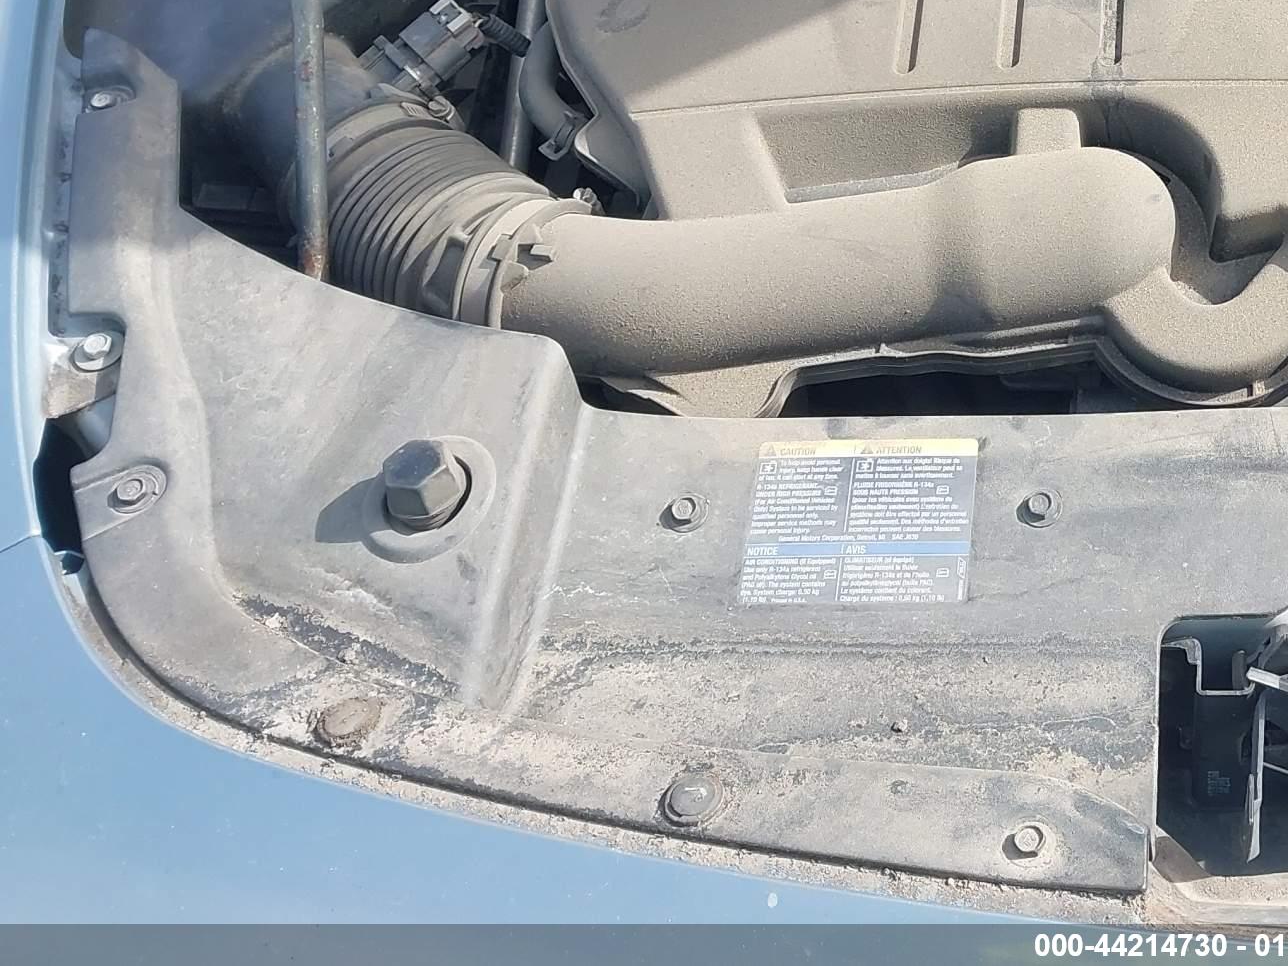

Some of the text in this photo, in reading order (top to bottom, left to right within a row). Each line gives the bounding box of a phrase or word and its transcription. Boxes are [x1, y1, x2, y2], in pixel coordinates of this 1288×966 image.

[781, 448, 816, 456] CAUTION
[877, 446, 921, 454] ATTENTION
[747, 547, 778, 555] NOTICE
[846, 545, 866, 554] AVIS
